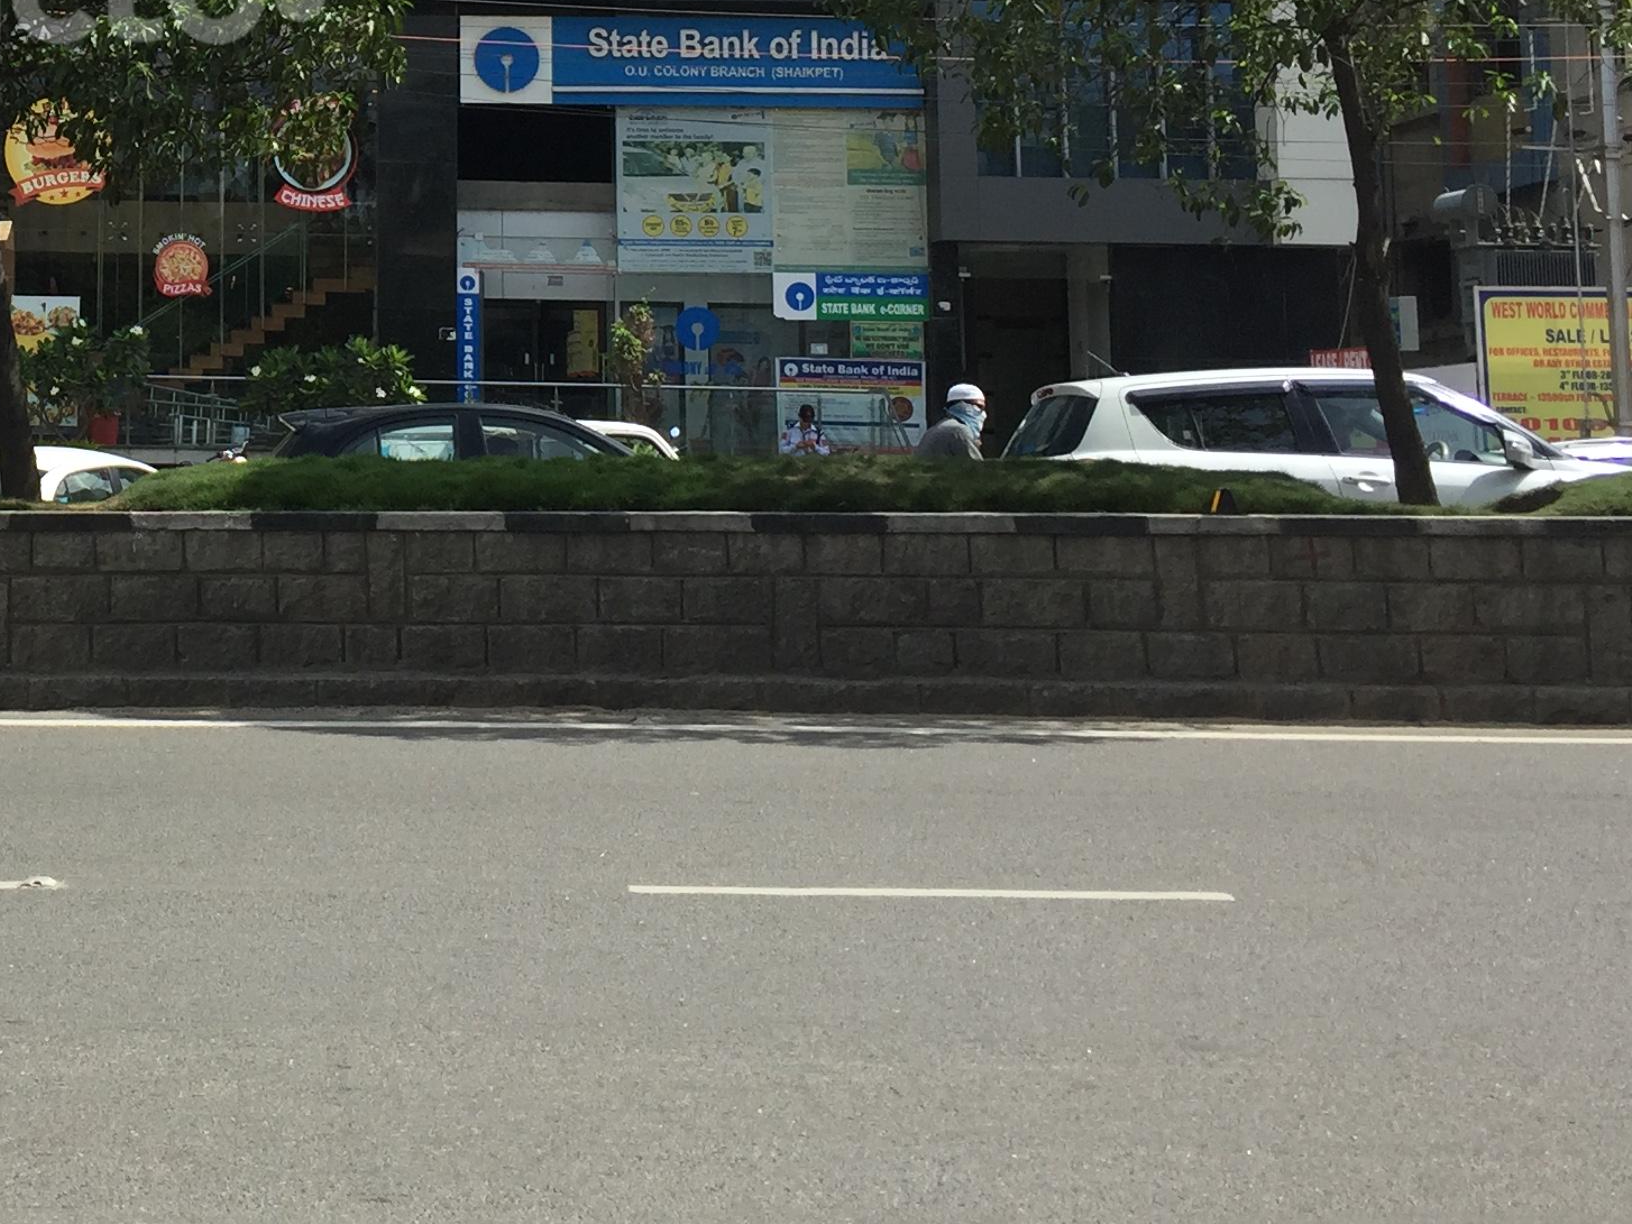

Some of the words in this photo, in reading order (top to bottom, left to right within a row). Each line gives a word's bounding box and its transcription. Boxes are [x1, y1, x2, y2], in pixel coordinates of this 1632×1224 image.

[588, 27, 668, 59] State
[679, 29, 760, 59] Bank
[769, 29, 803, 60] of
[810, 30, 888, 61] India
[624, 64, 650, 77] O.U.
[654, 65, 708, 77] COLONY
[710, 66, 765, 78] BRANCH
[771, 66, 844, 80] (SHAIKPET)
[20, 171, 102, 195] BURGERS
[280, 190, 345, 208] CHINESE
[187, 234, 206, 249] HOT
[162, 282, 202, 295] PIZZAS
[821, 303, 849, 315] STATE
[851, 303, 876, 315] BANK
[879, 304, 925, 316] e-CORNER
[1491, 302, 1523, 319] WEST
[1526, 302, 1566, 319] WORLD
[463, 297, 474, 340] STATE
[1545, 328, 1586, 344] SALE
[463, 345, 474, 379] BANK
[801, 363, 835, 374] State
[837, 364, 868, 375] Bank
[871, 364, 886, 376] of
[887, 365, 918, 376] India
